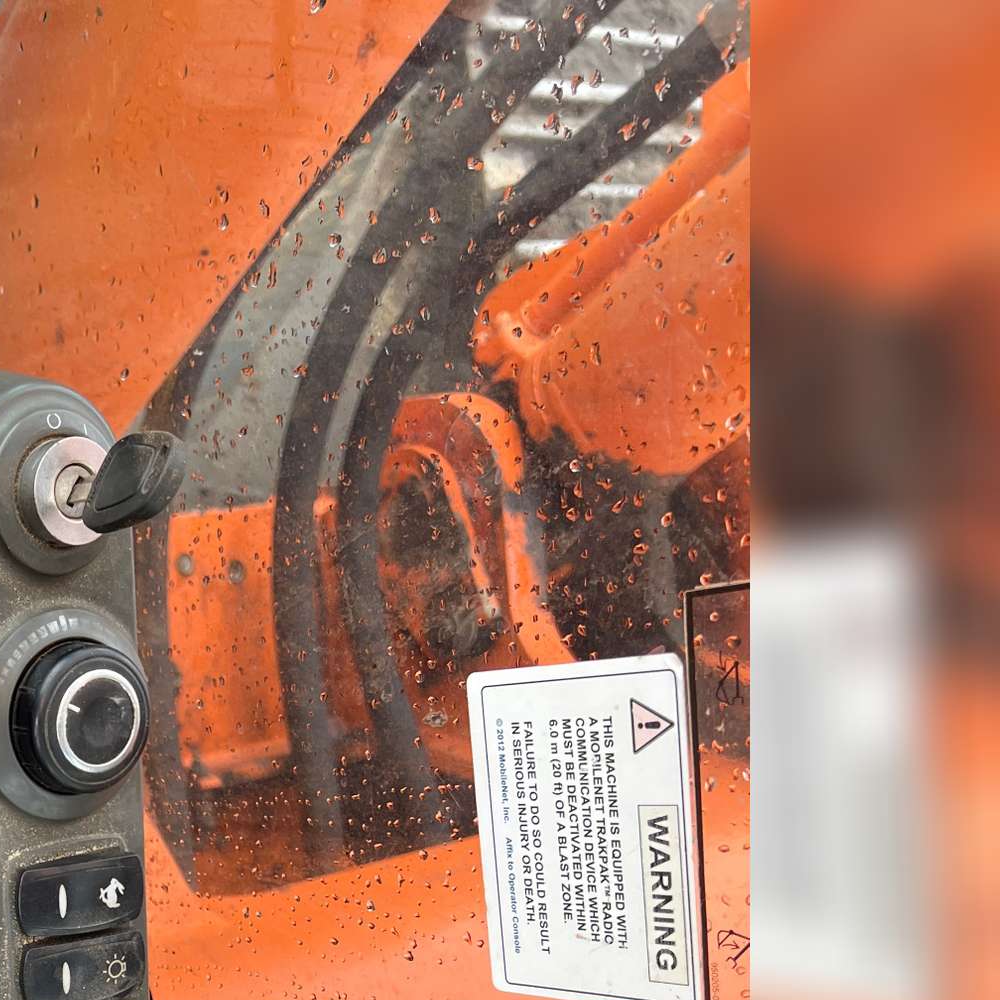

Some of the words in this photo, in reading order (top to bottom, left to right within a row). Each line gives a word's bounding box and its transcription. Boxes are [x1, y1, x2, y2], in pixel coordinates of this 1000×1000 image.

[511, 722, 520, 734] IN
[548, 719, 558, 738] 6.0
[562, 718, 573, 757] MUST
[602, 715, 614, 748] THIS
[523, 721, 536, 779] FAILURE
[550, 742, 557, 754] m
[550, 758, 561, 777] (20
[512, 739, 525, 798] SERIOUS
[565, 761, 575, 780] BE
[575, 717, 592, 837] COMMUNICATION
[605, 752, 618, 817] MACHINE
[528, 783, 538, 801] TO
[552, 782, 563, 795] ft)
[517, 803, 529, 851] INJURY
[530, 805, 539, 825] DO
[555, 799, 565, 818] OF
[556, 822, 565, 832] A
[610, 822, 620, 834] IS
[505, 837, 513, 858] Affix
[532, 829, 541, 848] SO
[566, 784, 582, 880] DEACTIVATED
[588, 716, 598, 726] A
[602, 901, 614, 944] RADIO
[507, 861, 513, 870] to
[521, 854, 531, 873] OR
[534, 852, 545, 898] COULD
[557, 836, 569, 880] BLAST
[584, 842, 596, 892] DEVICE
[611, 839, 625, 910] EQUIPPED
[508, 872, 517, 913] Operator
[523, 878, 535, 924] DEATH.
[561, 883, 573, 923] ZONE.
[574, 884, 586, 931] WITHIN
[647, 815, 677, 970] WARNING
[512, 916, 520, 953] Console
[538, 902, 550, 954] RESULT
[588, 896, 600, 942] WHICH
[616, 914, 627, 948] WITH
